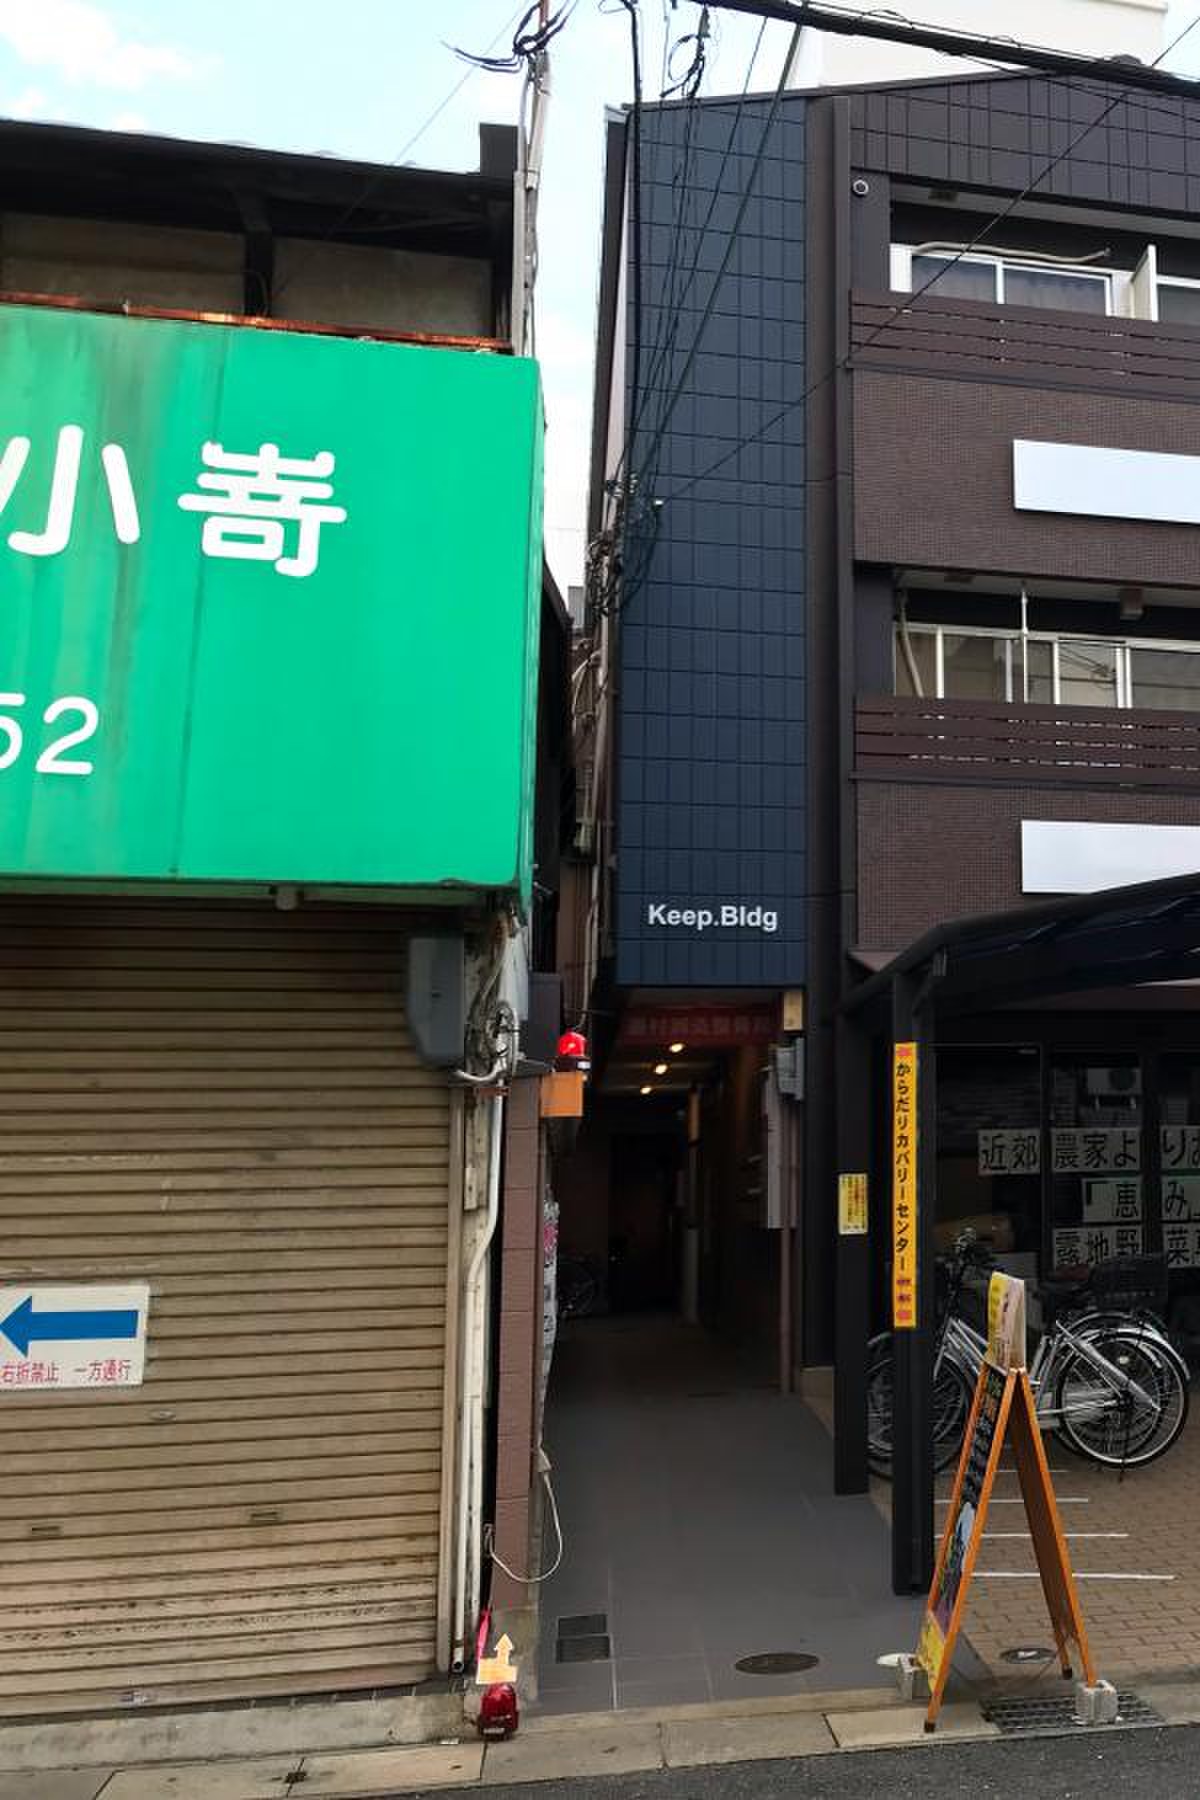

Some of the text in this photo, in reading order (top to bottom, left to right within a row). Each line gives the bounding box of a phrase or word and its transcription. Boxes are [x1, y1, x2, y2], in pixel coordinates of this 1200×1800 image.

[647, 903, 778, 931] Keep.Bldg
[74, 1359, 131, 1382] 一方通行
